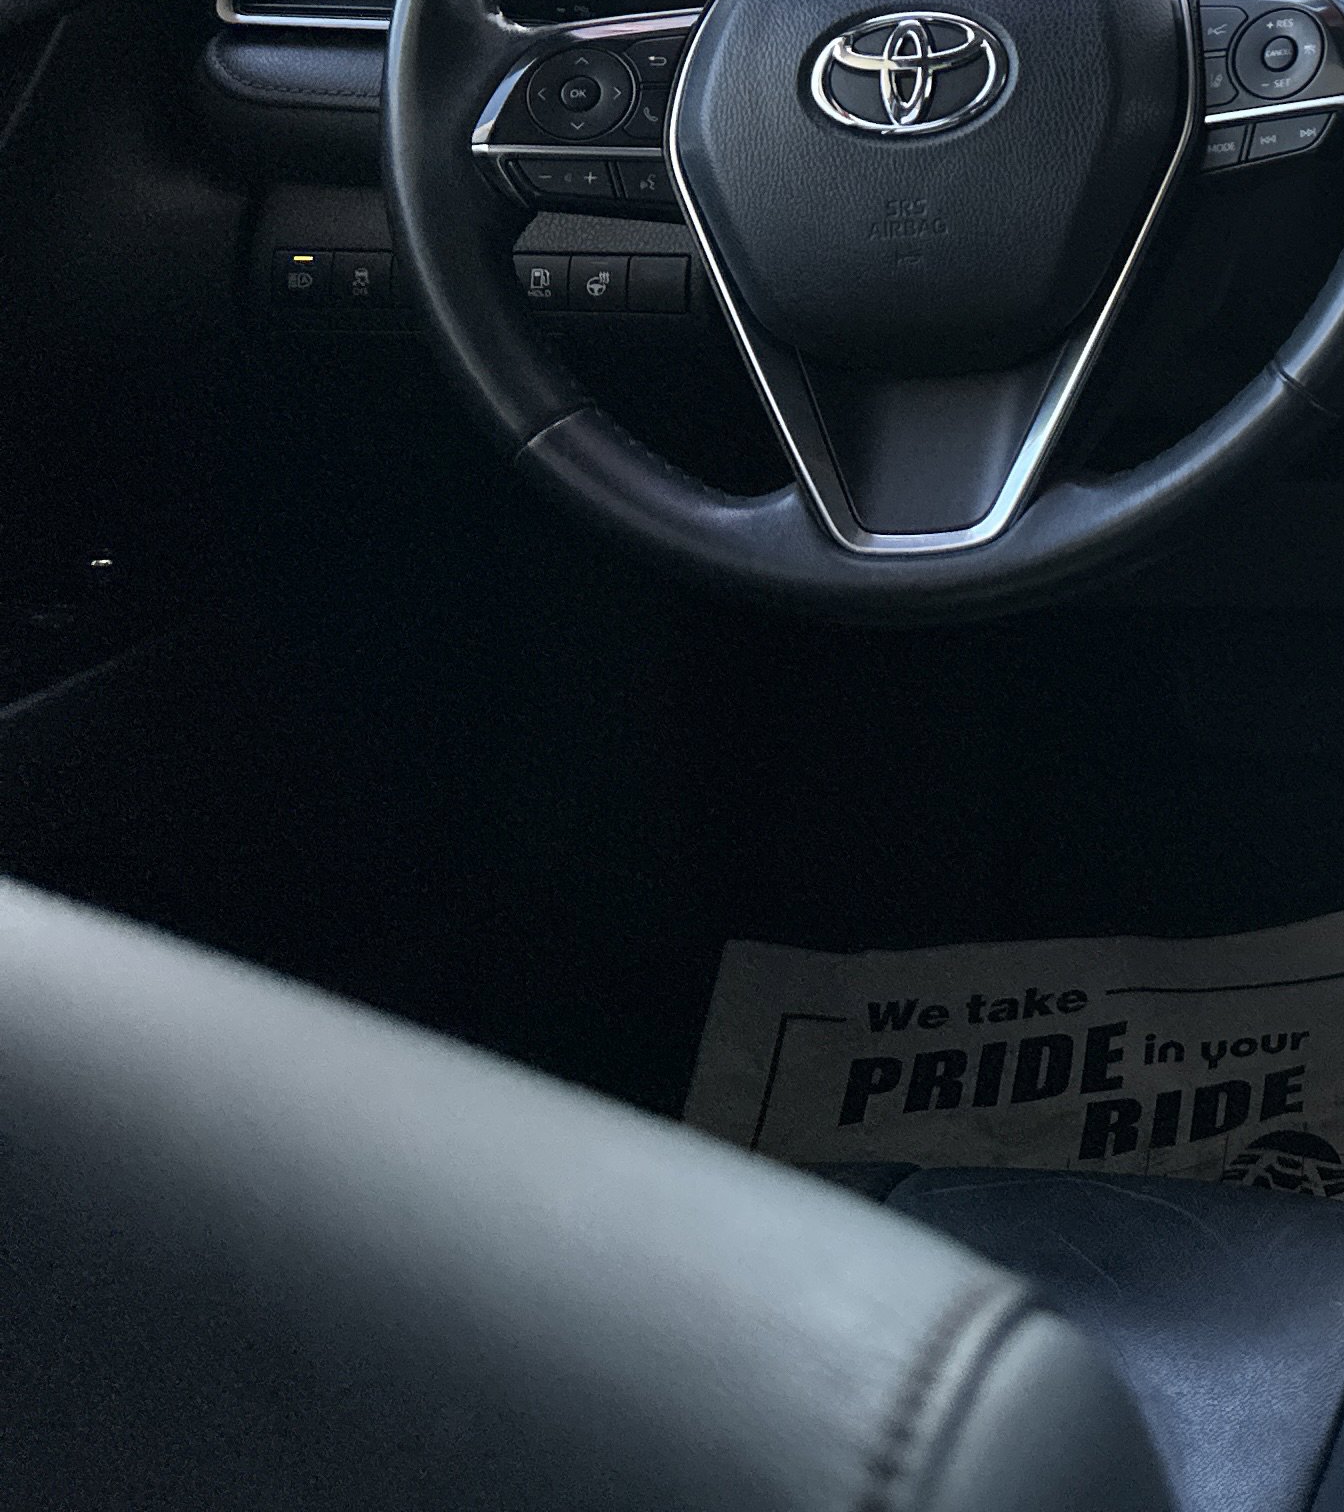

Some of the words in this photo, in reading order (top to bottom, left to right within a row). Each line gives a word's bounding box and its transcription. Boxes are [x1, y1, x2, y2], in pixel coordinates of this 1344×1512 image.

[1276, 18, 1294, 28] RES
[1274, 78, 1291, 88] SET
[569, 88, 586, 99] OK
[1207, 141, 1236, 153] MODE
[887, 199, 928, 218] SRS
[870, 218, 949, 240] AIRBAG
[527, 289, 551, 297] HOLD
[866, 998, 949, 1034] We
[965, 986, 1089, 1026] take
[837, 1020, 1128, 1128] PRIDE
[1143, 1033, 1185, 1066] in
[1200, 1027, 1311, 1069] your
[1077, 1064, 1306, 1160] RIDE
